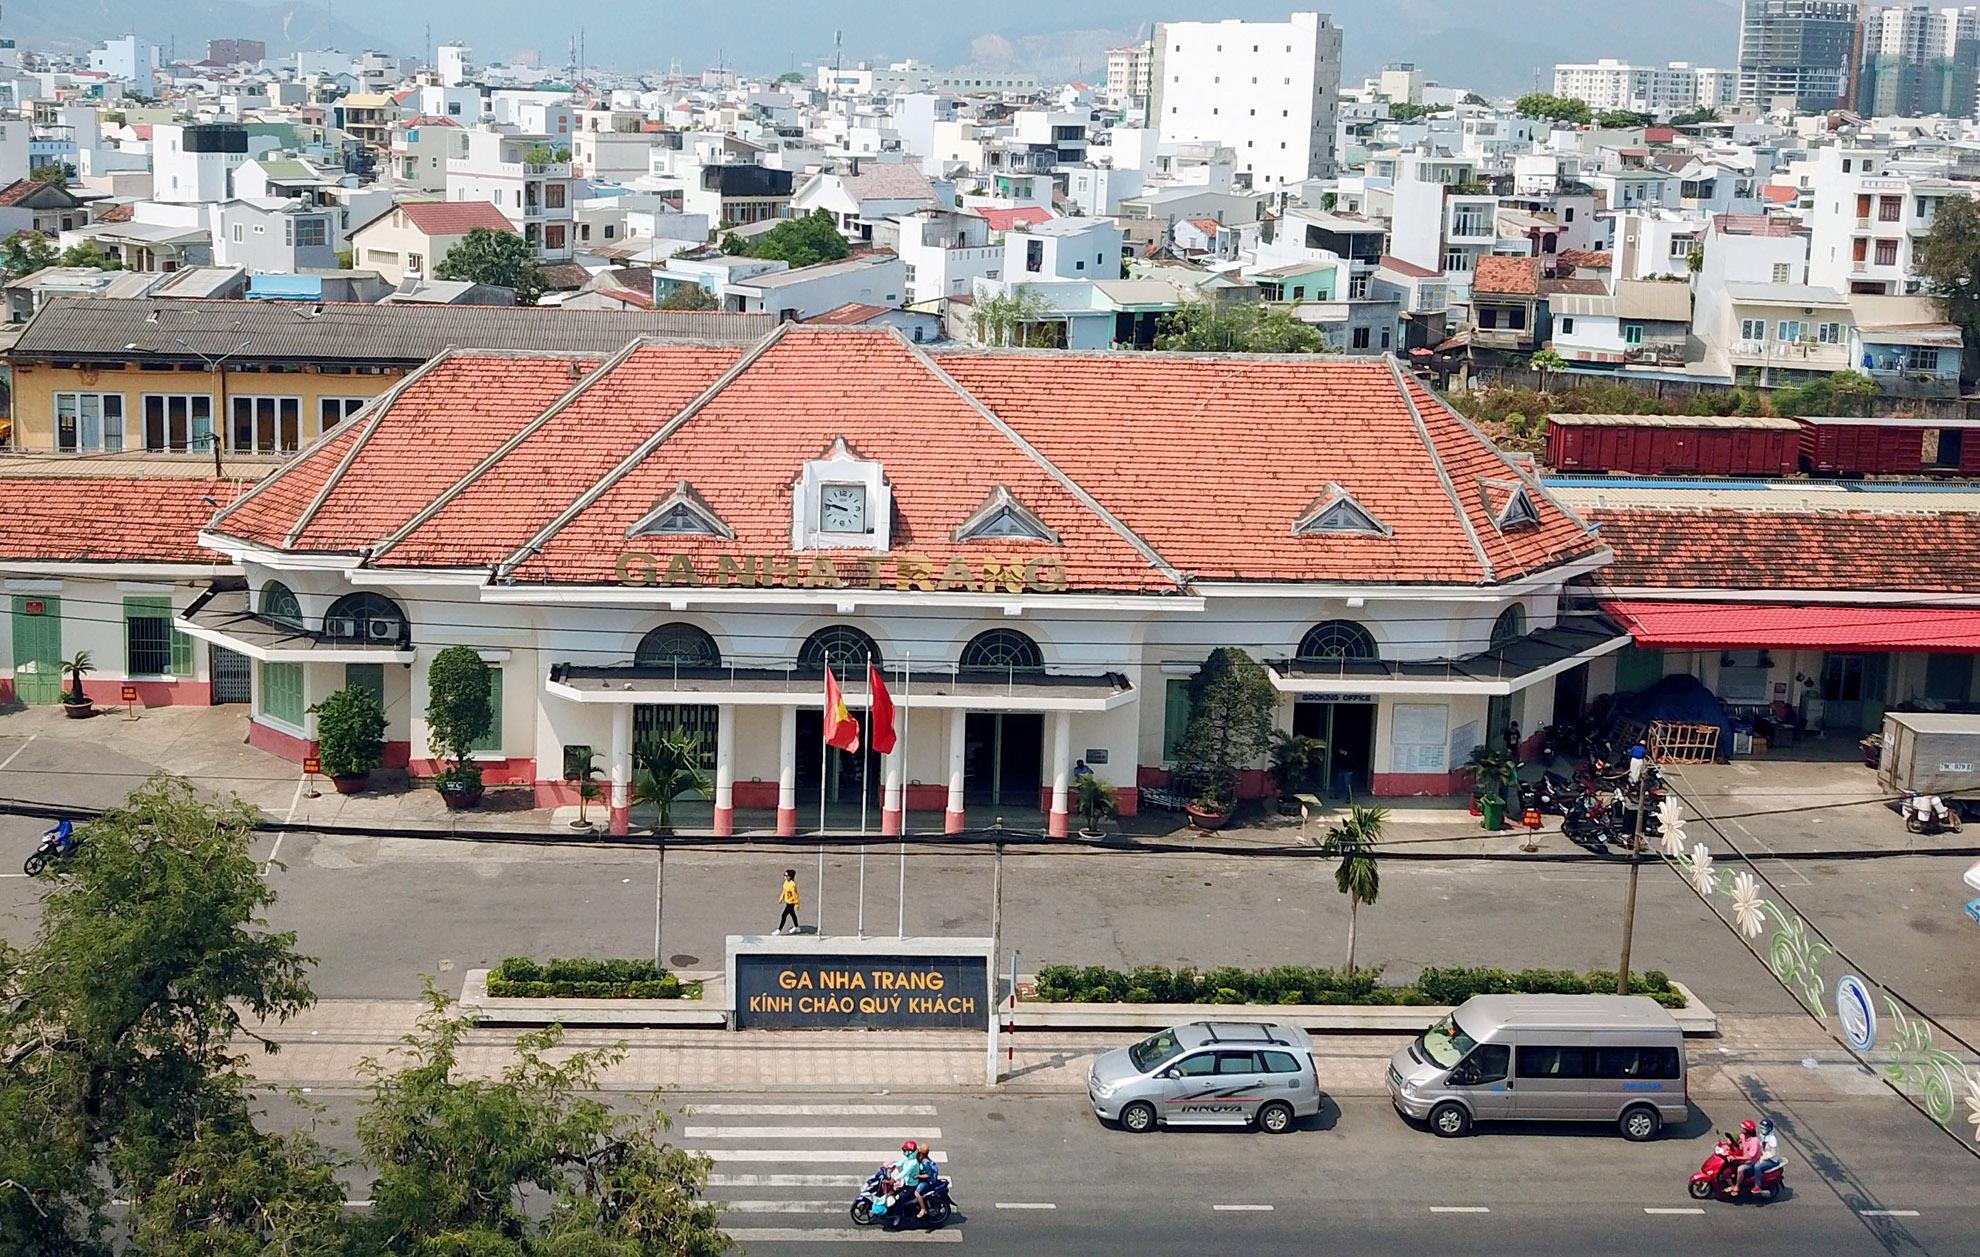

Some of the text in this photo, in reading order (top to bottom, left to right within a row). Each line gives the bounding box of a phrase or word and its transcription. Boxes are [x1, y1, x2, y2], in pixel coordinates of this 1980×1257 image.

[615, 552, 1067, 594] GA NHA TRANG
[446, 781, 463, 789] WC
[779, 970, 945, 991] GA NHA TRANG
[749, 992, 975, 1014] KÍNH CHÀO QUÝ KHÁCH
[1181, 1104, 1242, 1113] INNOVA
